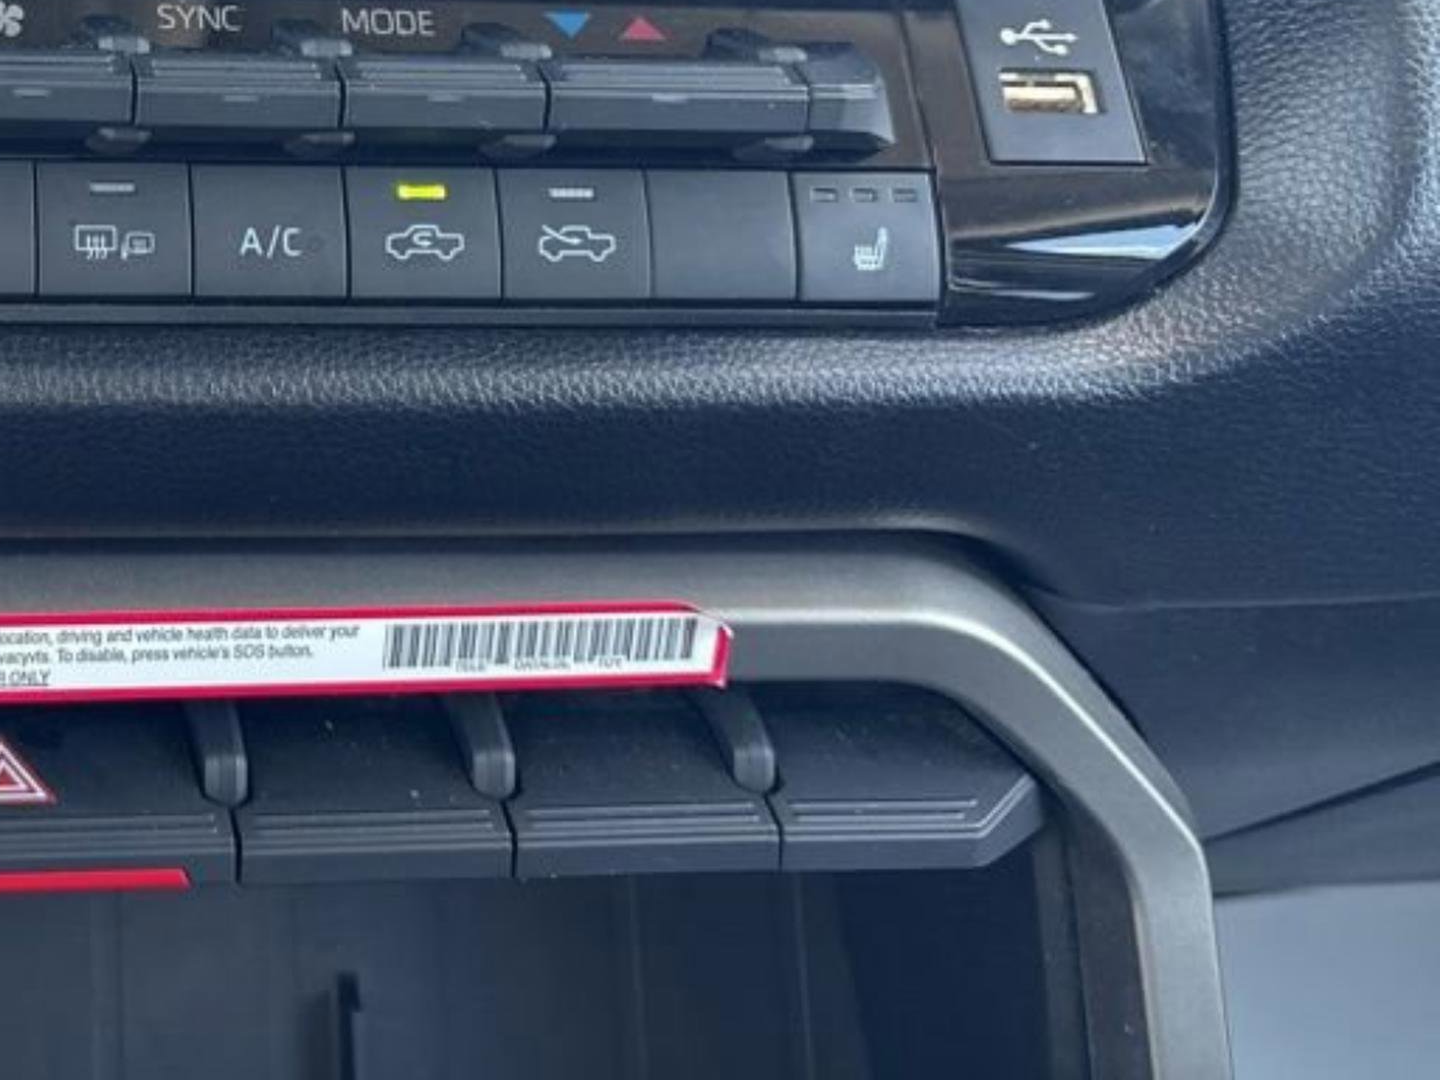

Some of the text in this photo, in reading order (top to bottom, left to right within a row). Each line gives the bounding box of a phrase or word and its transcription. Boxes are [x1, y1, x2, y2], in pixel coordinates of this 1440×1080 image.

[157, 4, 241, 32] SYNC
[342, 7, 436, 38] MODE
[240, 226, 302, 258] A/C
[56, 626, 102, 645] driving
[106, 626, 133, 642] and
[136, 626, 184, 642] vehicle
[188, 625, 228, 641] health
[231, 624, 262, 639] data
[265, 624, 279, 638] to
[282, 623, 328, 639] deliver
[331, 624, 360, 640] your
[58, 649, 74, 663] To
[75, 647, 126, 663] disable,
[131, 648, 169, 664] press
[173, 646, 230, 660] vehicle's
[233, 644, 264, 659] SOS
[268, 643, 313, 658] button.
[9, 668, 51, 687] ONLY
